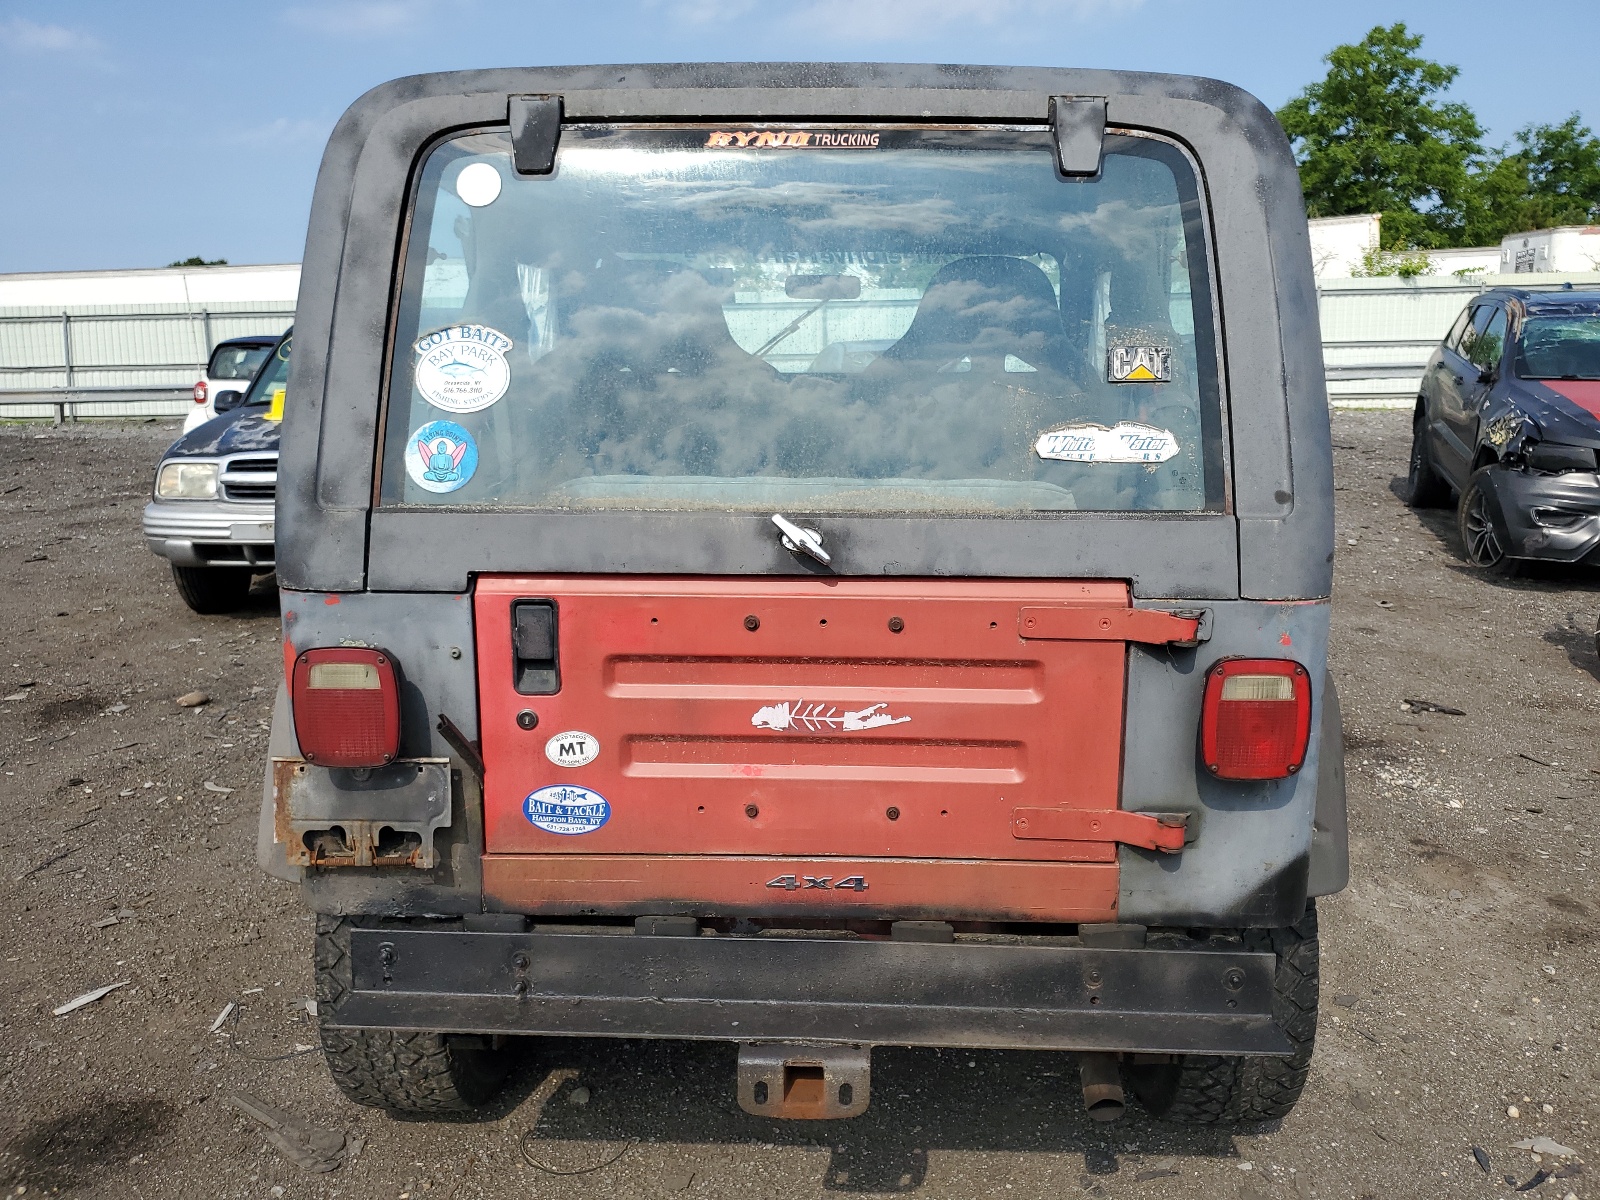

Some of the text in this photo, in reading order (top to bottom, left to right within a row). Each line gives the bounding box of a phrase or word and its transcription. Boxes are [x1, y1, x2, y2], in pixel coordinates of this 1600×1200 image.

[814, 133, 880, 146] TRUCKING
[418, 326, 509, 351] GOT BAIT?
[428, 345, 498, 366] BAY PARK
[1113, 347, 1167, 380] CAT
[431, 390, 461, 404] FISHING
[559, 741, 586, 757] MT
[528, 799, 606, 817] BAIT & TACKLE
[532, 814, 566, 823] HAMPTON
[590, 817, 602, 825] NY
